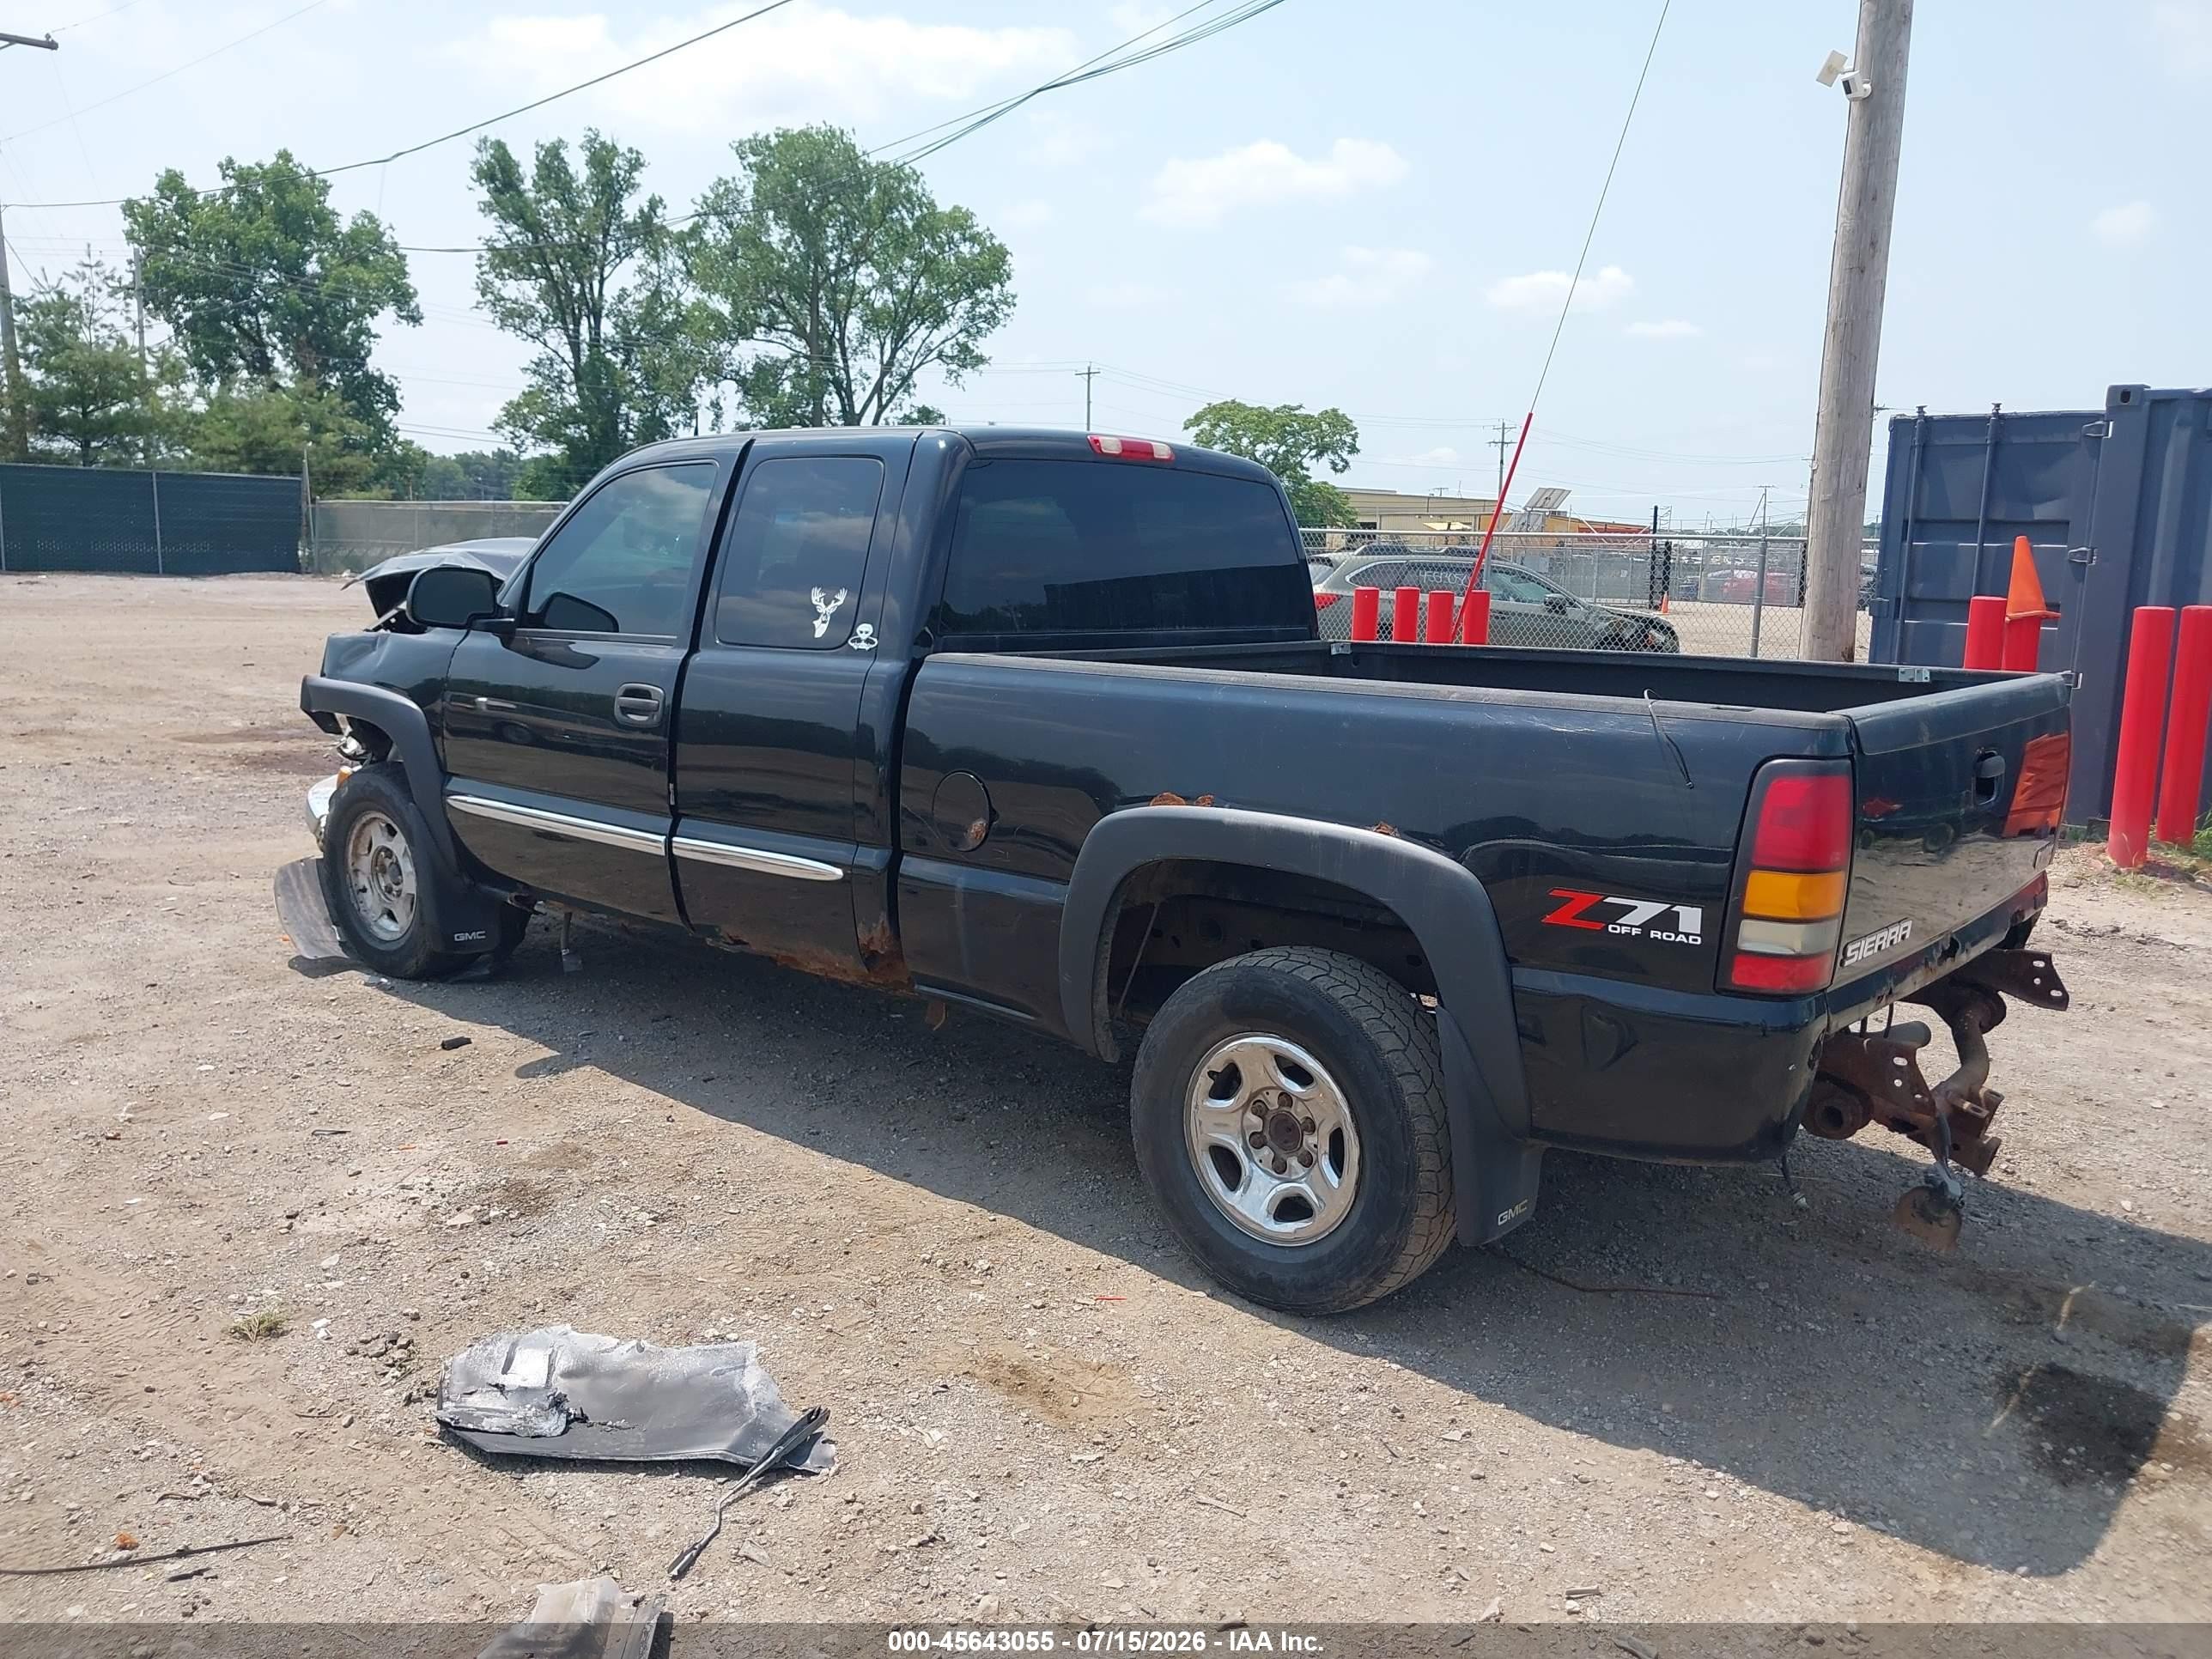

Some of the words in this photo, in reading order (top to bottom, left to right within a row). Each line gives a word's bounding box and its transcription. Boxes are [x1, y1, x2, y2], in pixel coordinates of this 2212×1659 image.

[1541, 890, 1702, 933] Z71
[453, 931, 486, 942] GMC
[1607, 924, 1642, 936] OFF
[1650, 930, 1702, 945] ROAD
[1844, 920, 1912, 967] SIERRA
[1498, 1199, 1528, 1226] GMC
